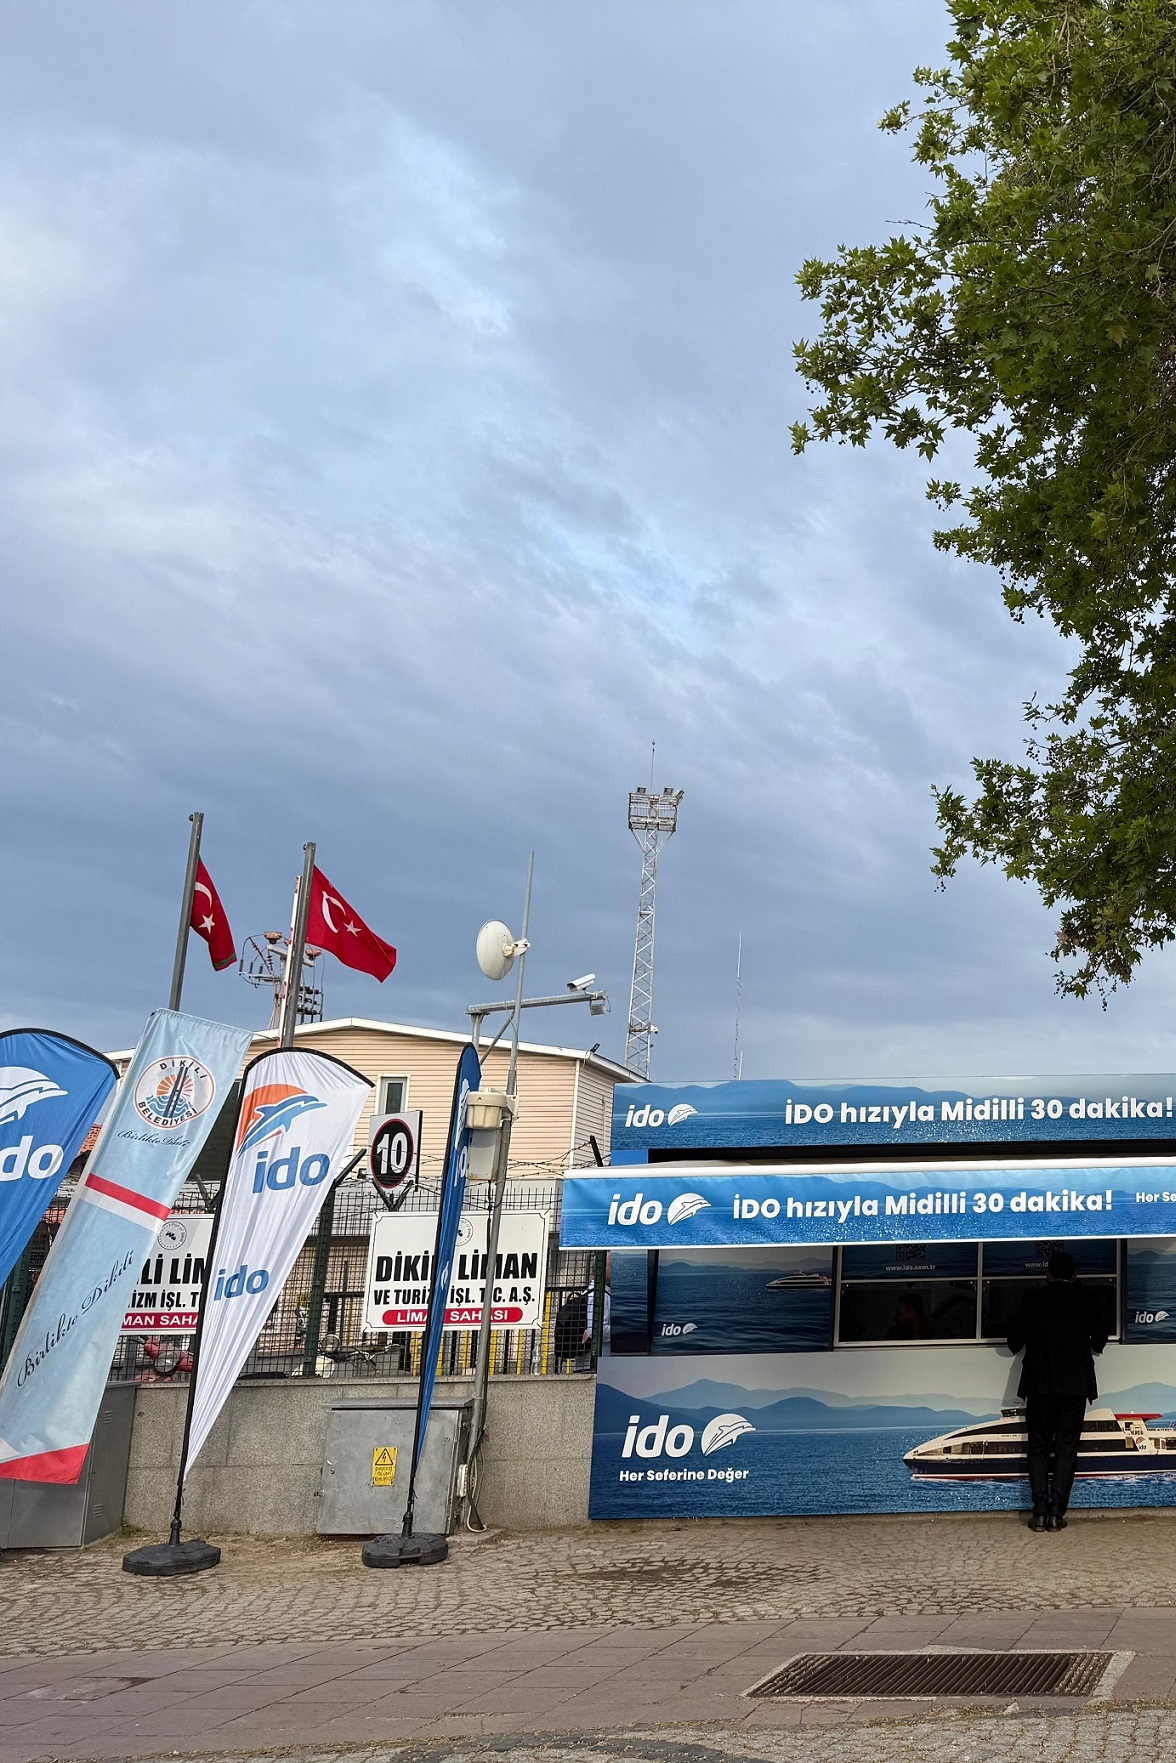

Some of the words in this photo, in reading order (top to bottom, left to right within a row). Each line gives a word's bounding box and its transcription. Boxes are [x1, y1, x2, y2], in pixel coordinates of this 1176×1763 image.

[625, 1104, 664, 1127] ido
[785, 1099, 834, 1124] İDO
[841, 1101, 934, 1128] hızıyla
[941, 1098, 1024, 1121] Midilli
[1031, 1099, 1062, 1120] 30
[1069, 1096, 1173, 1119] dakika!
[0, 1135, 64, 1181] do
[376, 1132, 408, 1174] 10
[252, 1147, 330, 1194] ido
[607, 1193, 663, 1226] ido
[733, 1194, 781, 1219] İDO
[787, 1196, 878, 1224] hızıyla
[885, 1191, 966, 1216] Midilli
[972, 1191, 1004, 1214] 30
[1010, 1189, 1112, 1213] dakika!
[375, 1250, 435, 1282] DİKİ
[213, 1265, 270, 1301] ido
[374, 1289, 390, 1305] VE
[394, 1286, 432, 1304] TURİ
[450, 1285, 475, 1307] İŞL.
[479, 1286, 506, 1303] TC.
[508, 1286, 536, 1305] A.Ş.
[130, 1289, 157, 1308] İZM
[160, 1288, 187, 1311] İŞL.
[17, 1313, 79, 1387] Birlikte
[81, 1250, 134, 1315] Dikili
[123, 1315, 155, 1326] MAN
[396, 1309, 428, 1323] LİMA
[449, 1309, 508, 1323] SAHSI
[661, 1323, 681, 1336] ido
[1134, 1311, 1154, 1324] ido
[621, 1415, 695, 1459] ido
[619, 1469, 644, 1481] Her
[647, 1468, 704, 1481] Seferine
[708, 1467, 749, 1483] Değer
